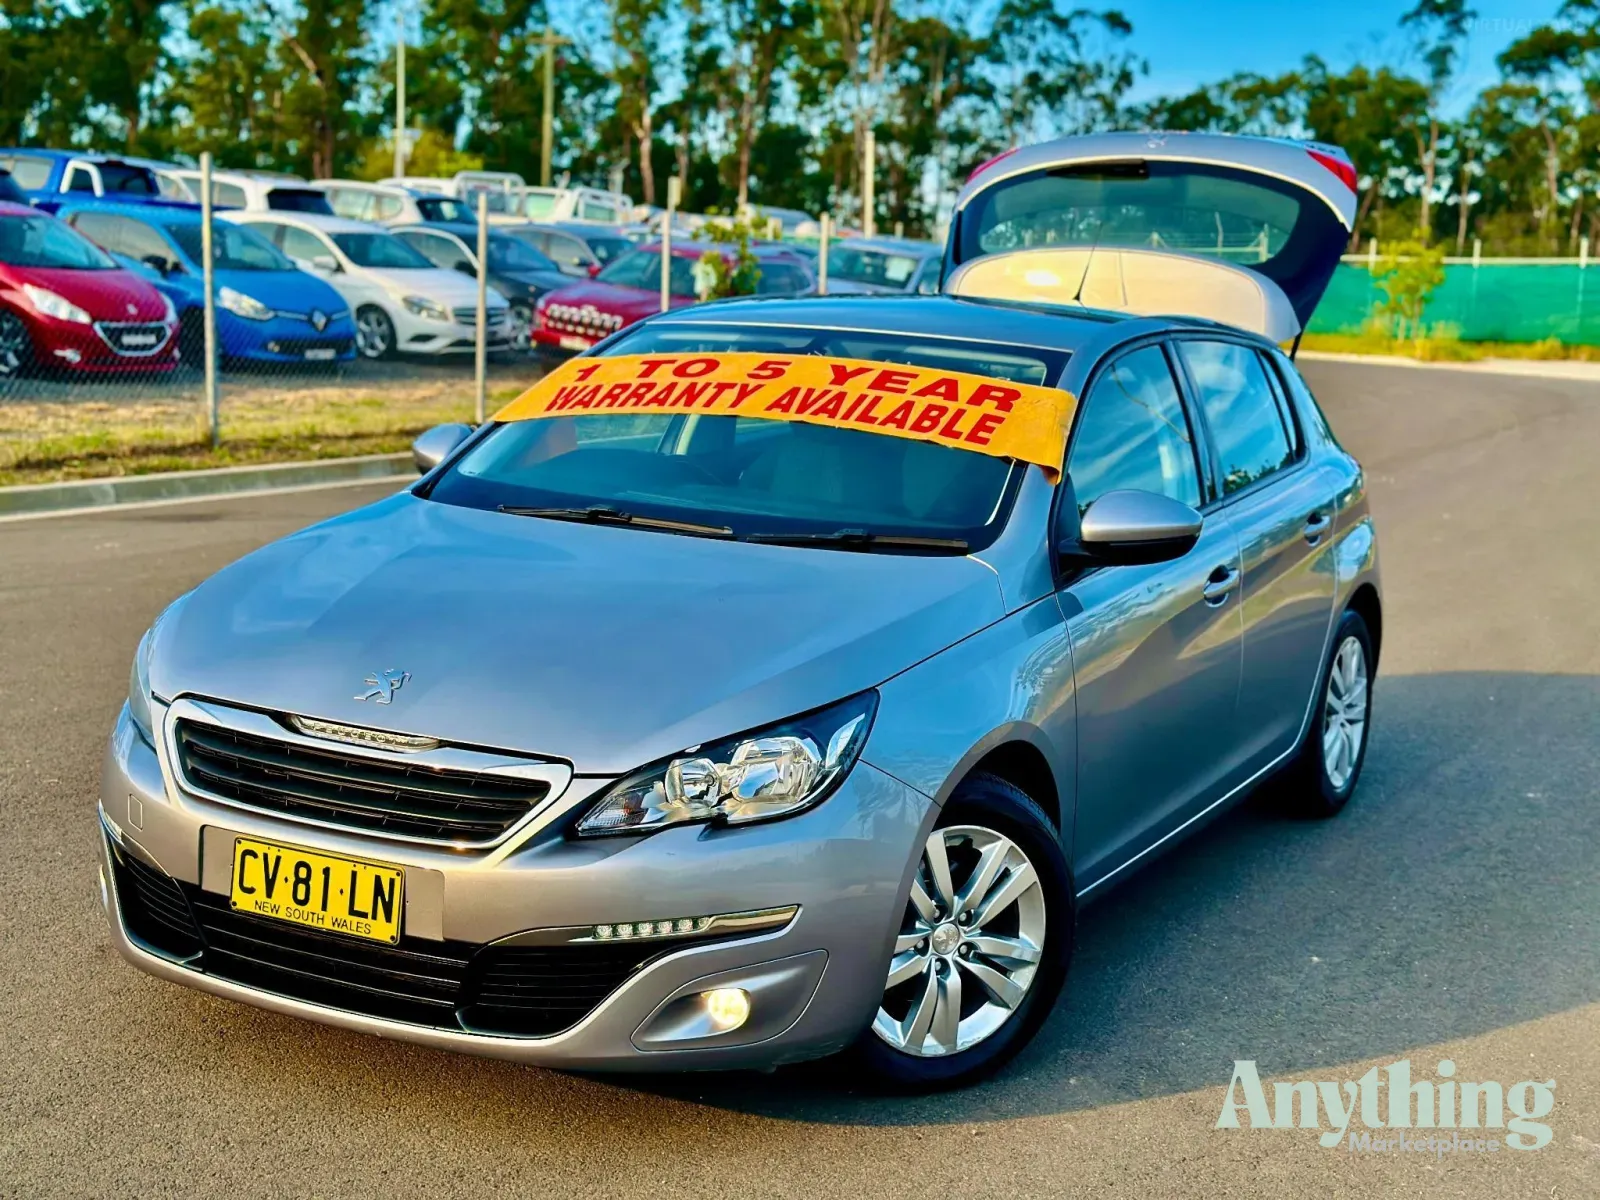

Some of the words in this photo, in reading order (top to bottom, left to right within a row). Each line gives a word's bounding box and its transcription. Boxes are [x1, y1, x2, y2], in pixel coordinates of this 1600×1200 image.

[575, 364, 601, 382] 1
[637, 358, 721, 379] TO
[746, 360, 792, 380] 5
[828, 364, 1022, 413] YEAR
[544, 381, 766, 412] WARRANTY
[763, 385, 1007, 446] AVAILABLE
[254, 899, 281, 915] NEW
[285, 906, 325, 926] SOUTH
[331, 915, 372, 935] WALES
